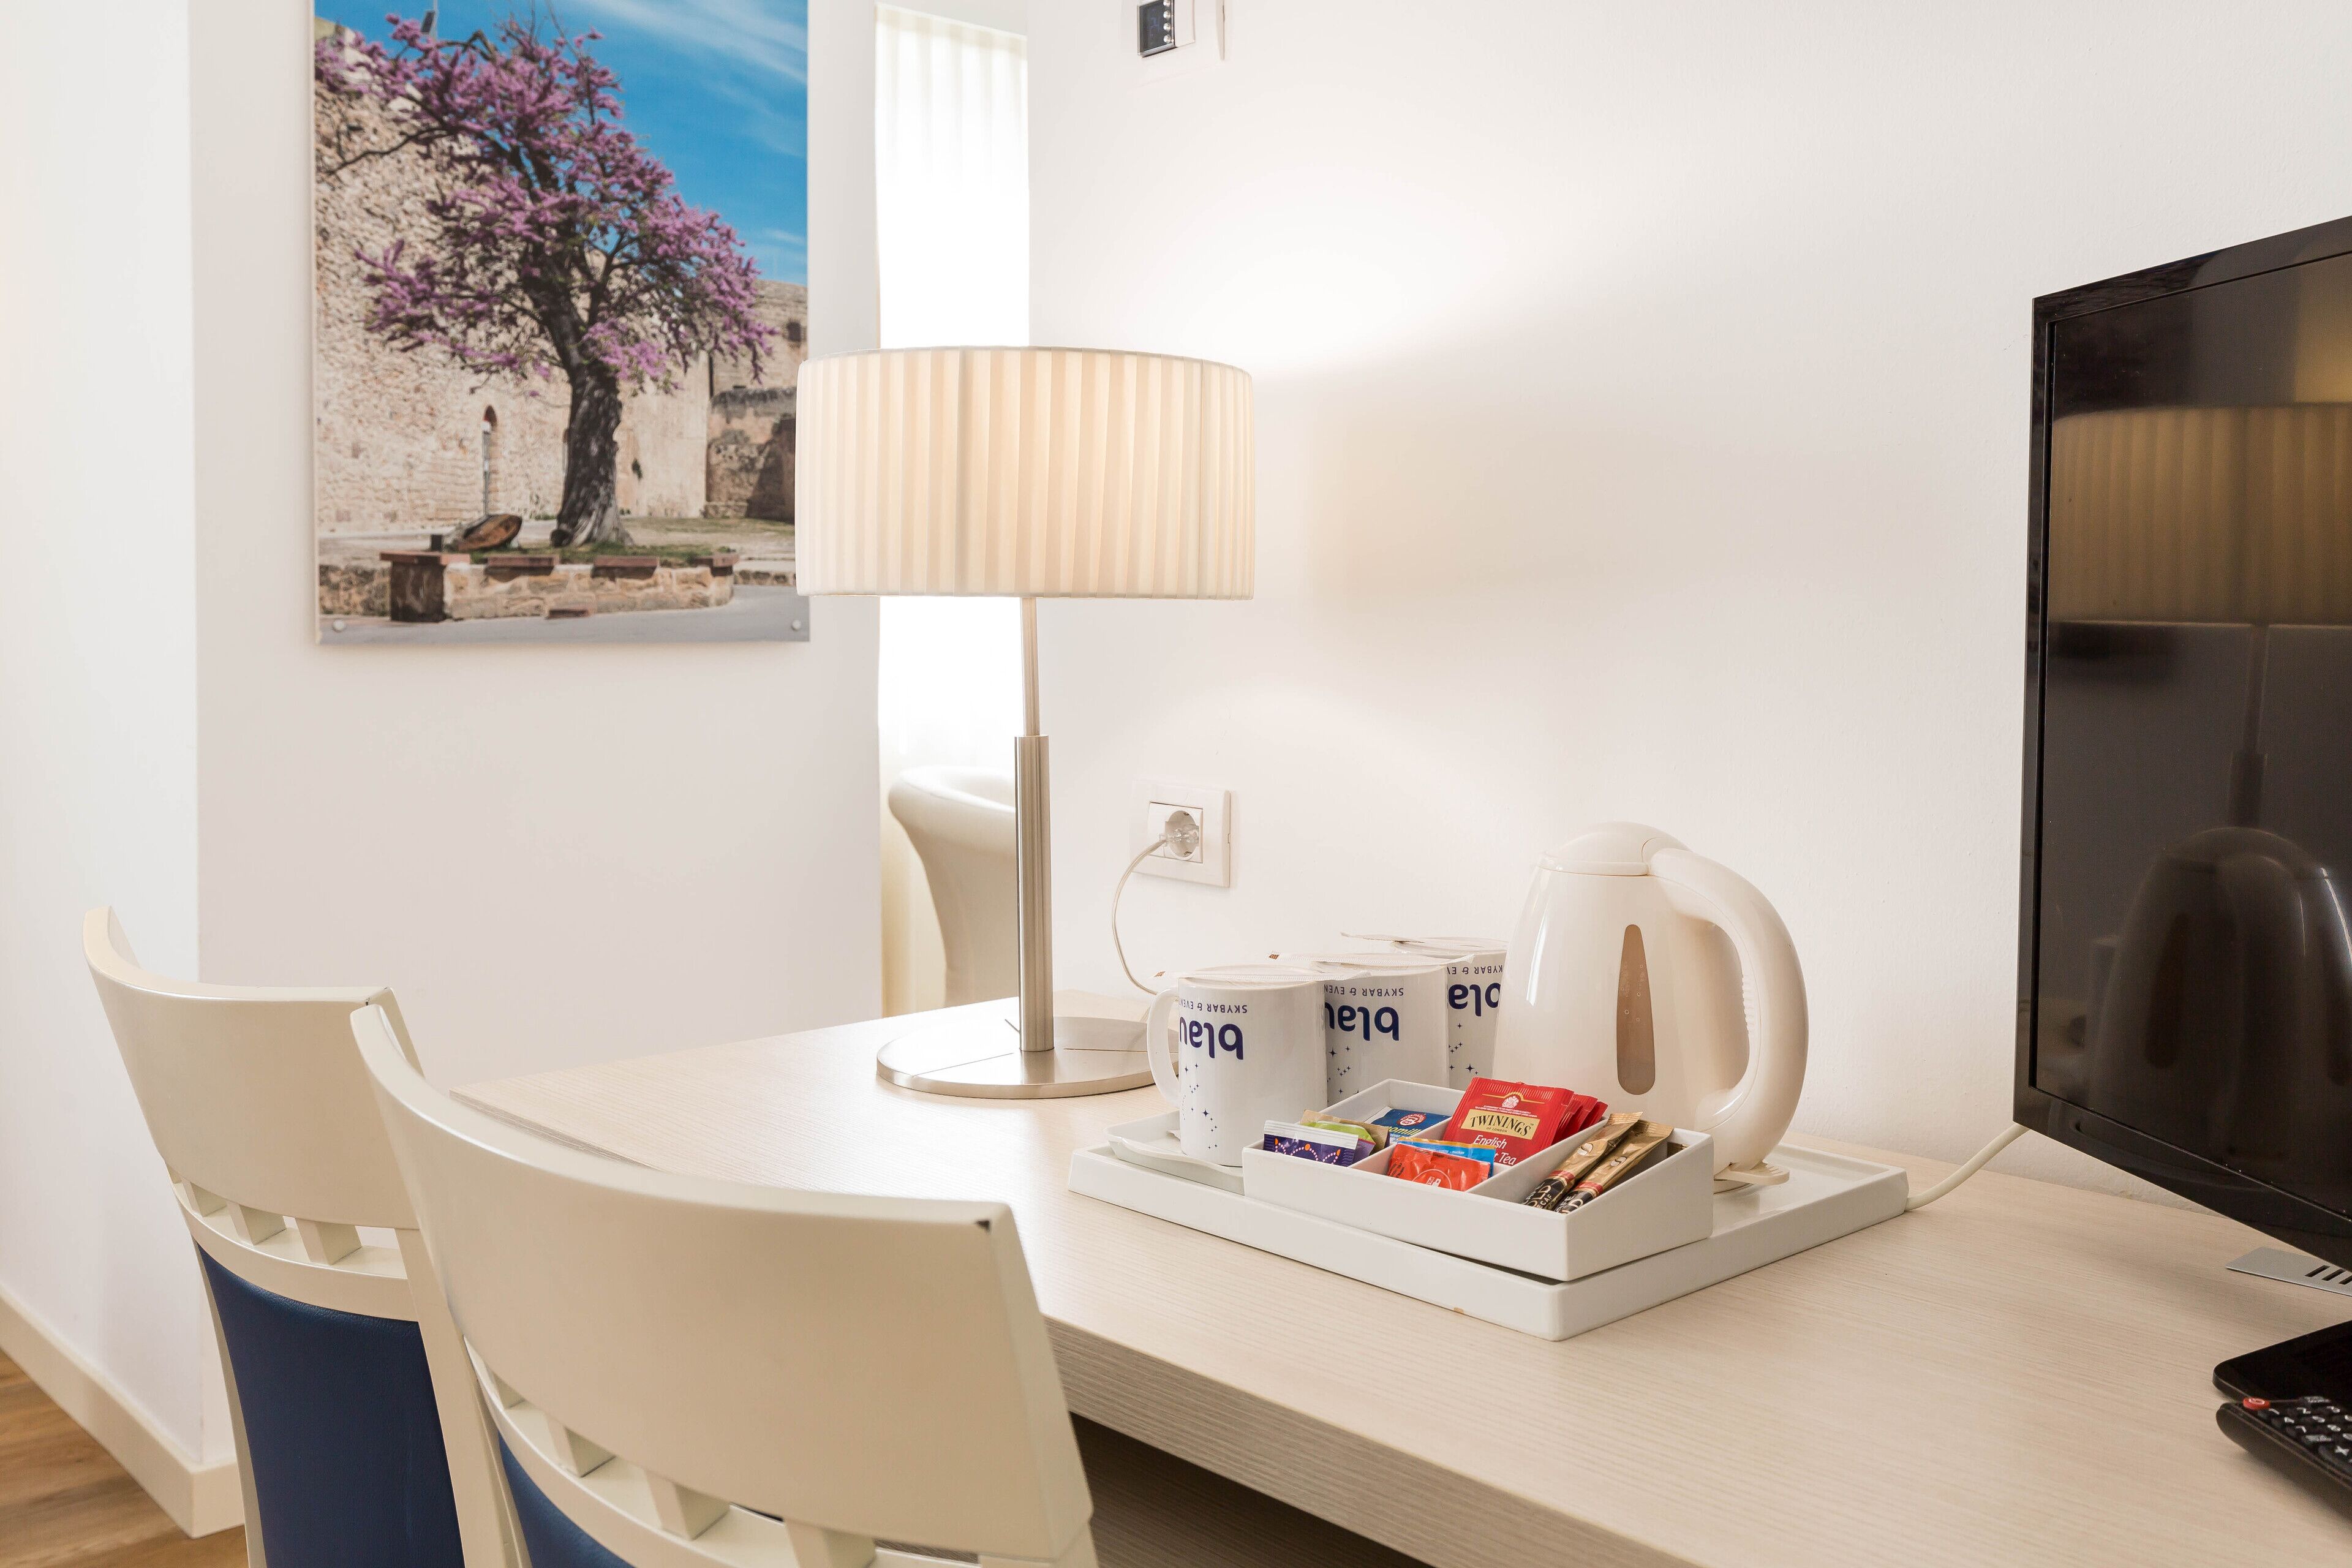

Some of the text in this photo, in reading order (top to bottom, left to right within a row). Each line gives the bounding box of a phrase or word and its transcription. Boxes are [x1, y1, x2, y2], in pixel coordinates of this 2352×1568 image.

[1474, 965, 1503, 974] KYBAR
[1324, 984, 1404, 997] SKYBAR & EVEN
[1179, 998, 1194, 1009] EVEN
[1207, 1003, 1248, 1014] SKYBAR
[1180, 1017, 1243, 1060] blau
[1470, 1114, 1531, 1136] TWININGS
[1472, 1134, 1507, 1149] English
[1499, 1152, 1517, 1166] Tea
[1537, 1194, 1552, 1208] ECAF
